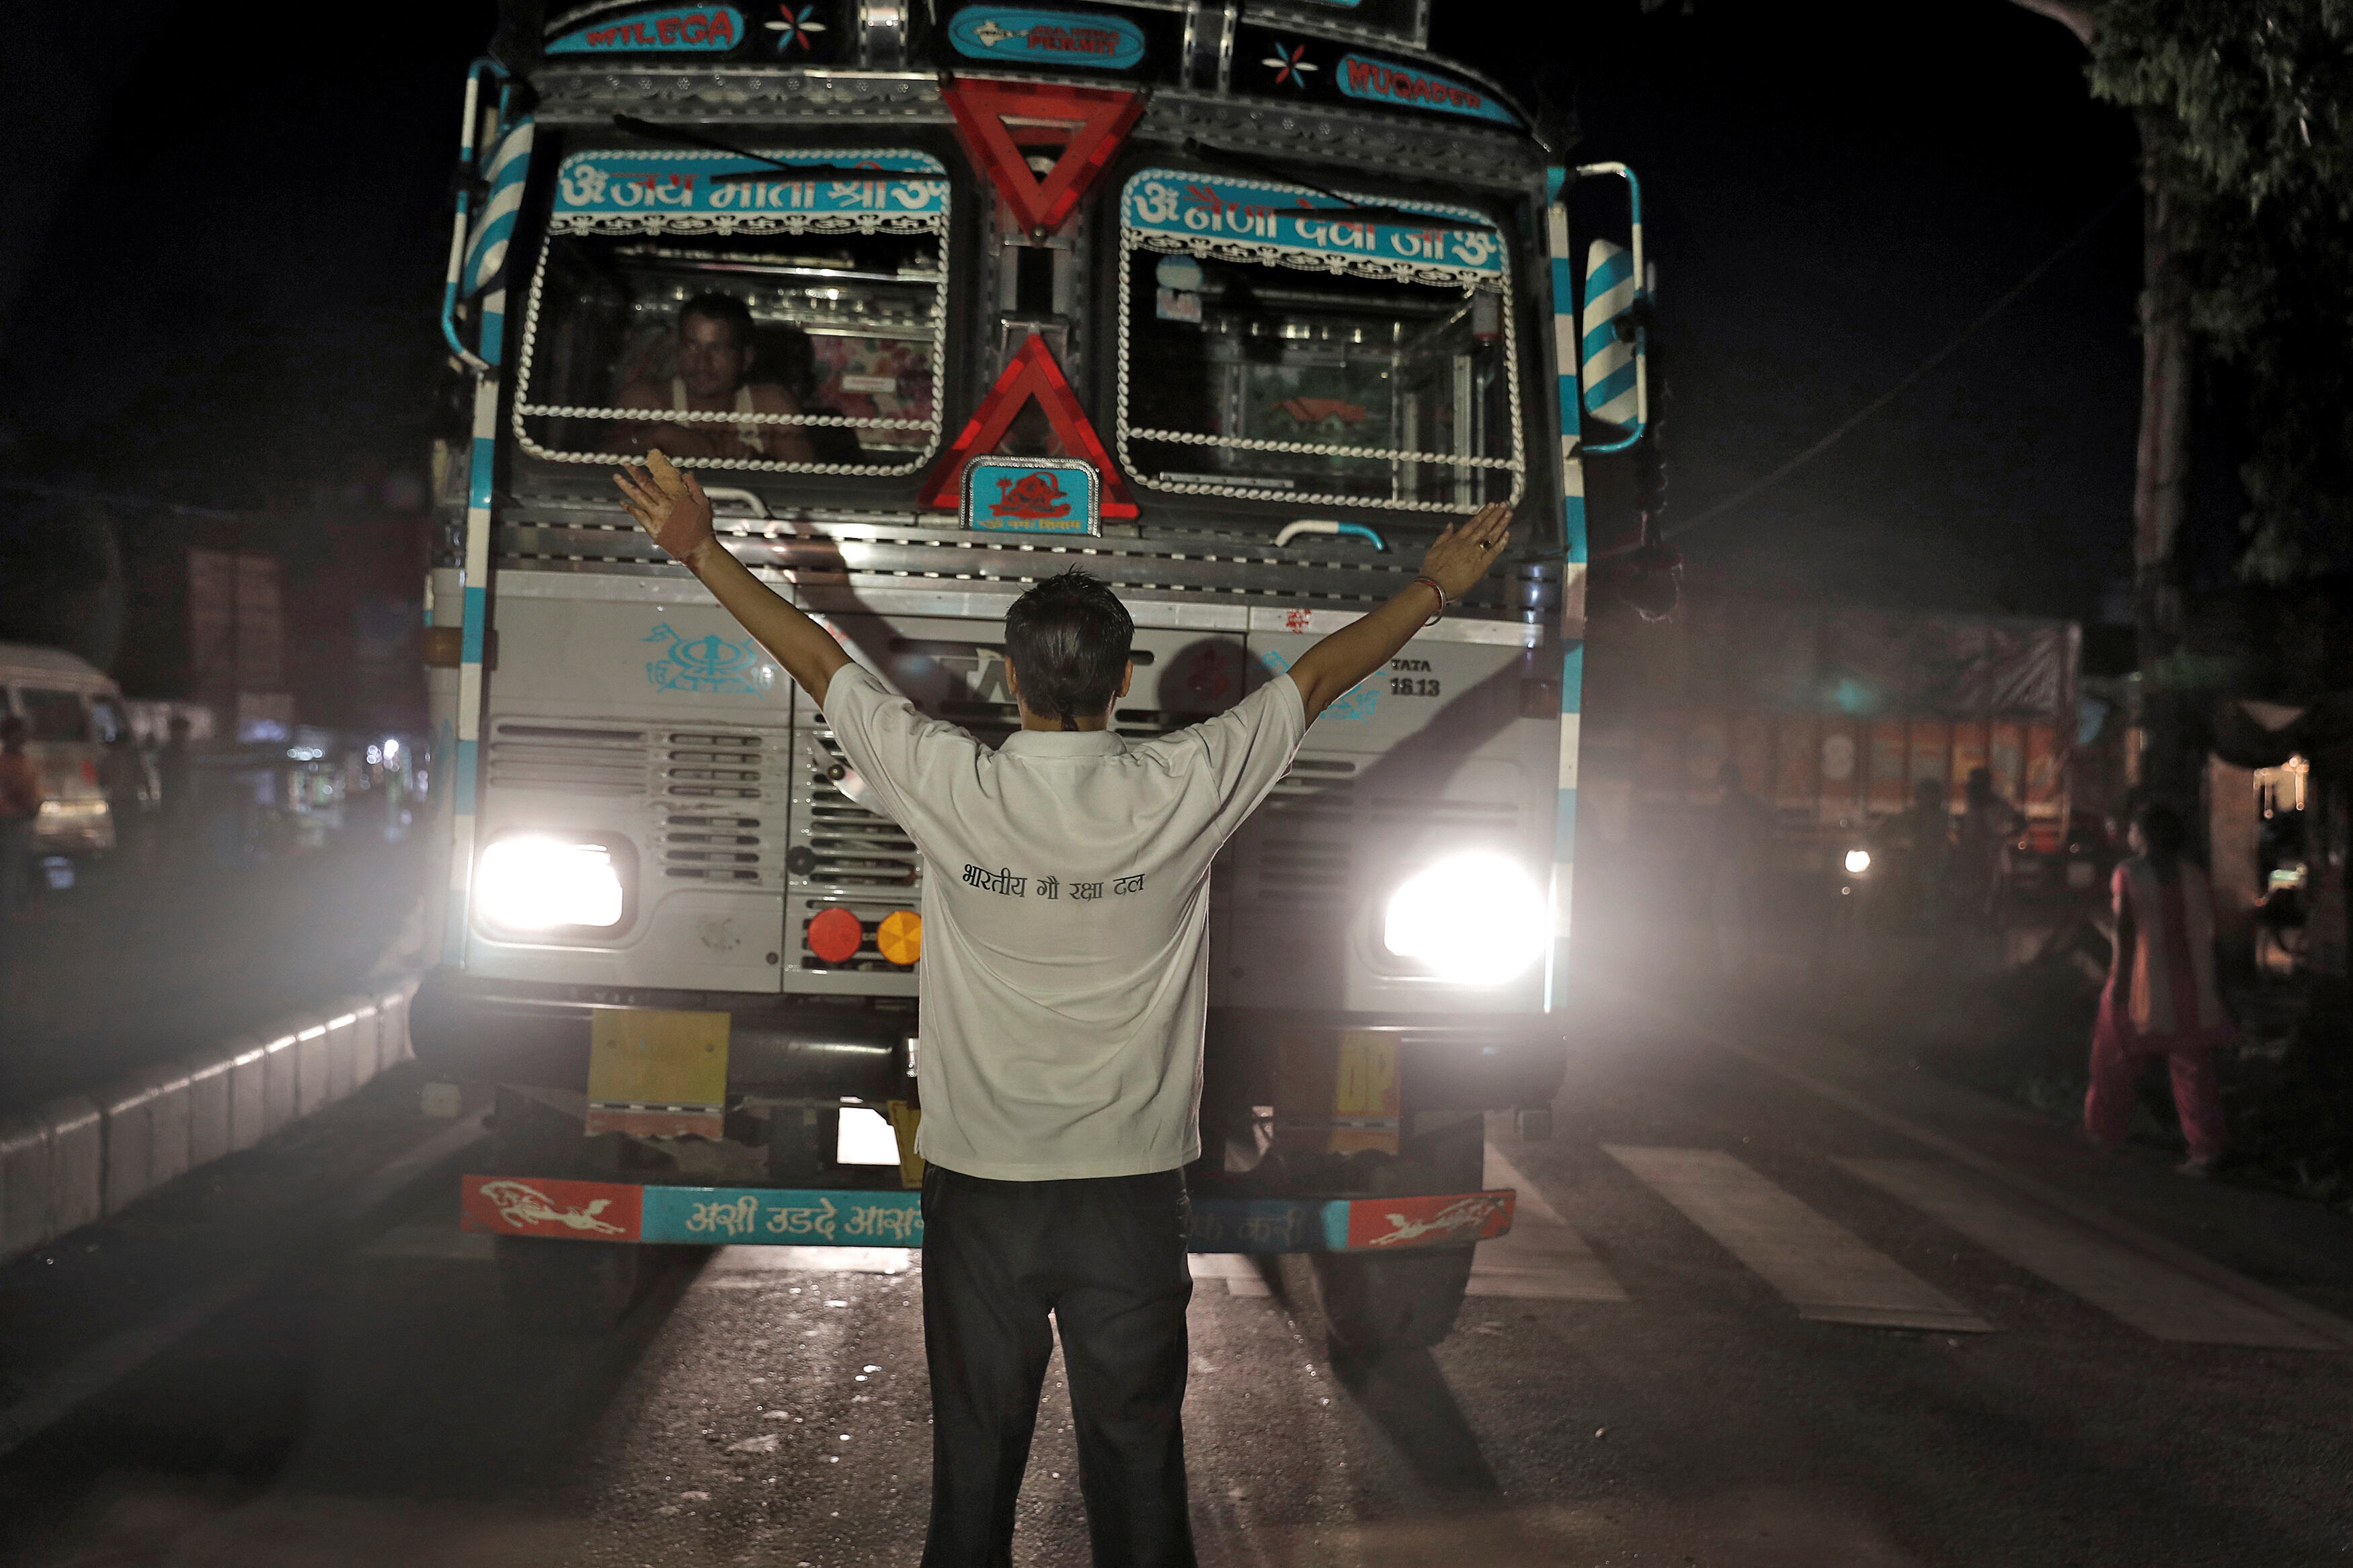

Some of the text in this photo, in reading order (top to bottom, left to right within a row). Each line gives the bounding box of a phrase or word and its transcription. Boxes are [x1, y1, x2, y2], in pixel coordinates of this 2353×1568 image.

[586, 10, 734, 46] MILEGA
[1028, 34, 1115, 55] PERMIT
[610, 172, 699, 207] जय
[709, 176, 815, 208] माता
[1390, 659, 1431, 672] TATA
[962, 864, 1145, 901] भारतीय गौ रक्षा दल
[685, 1195, 759, 1236] असी
